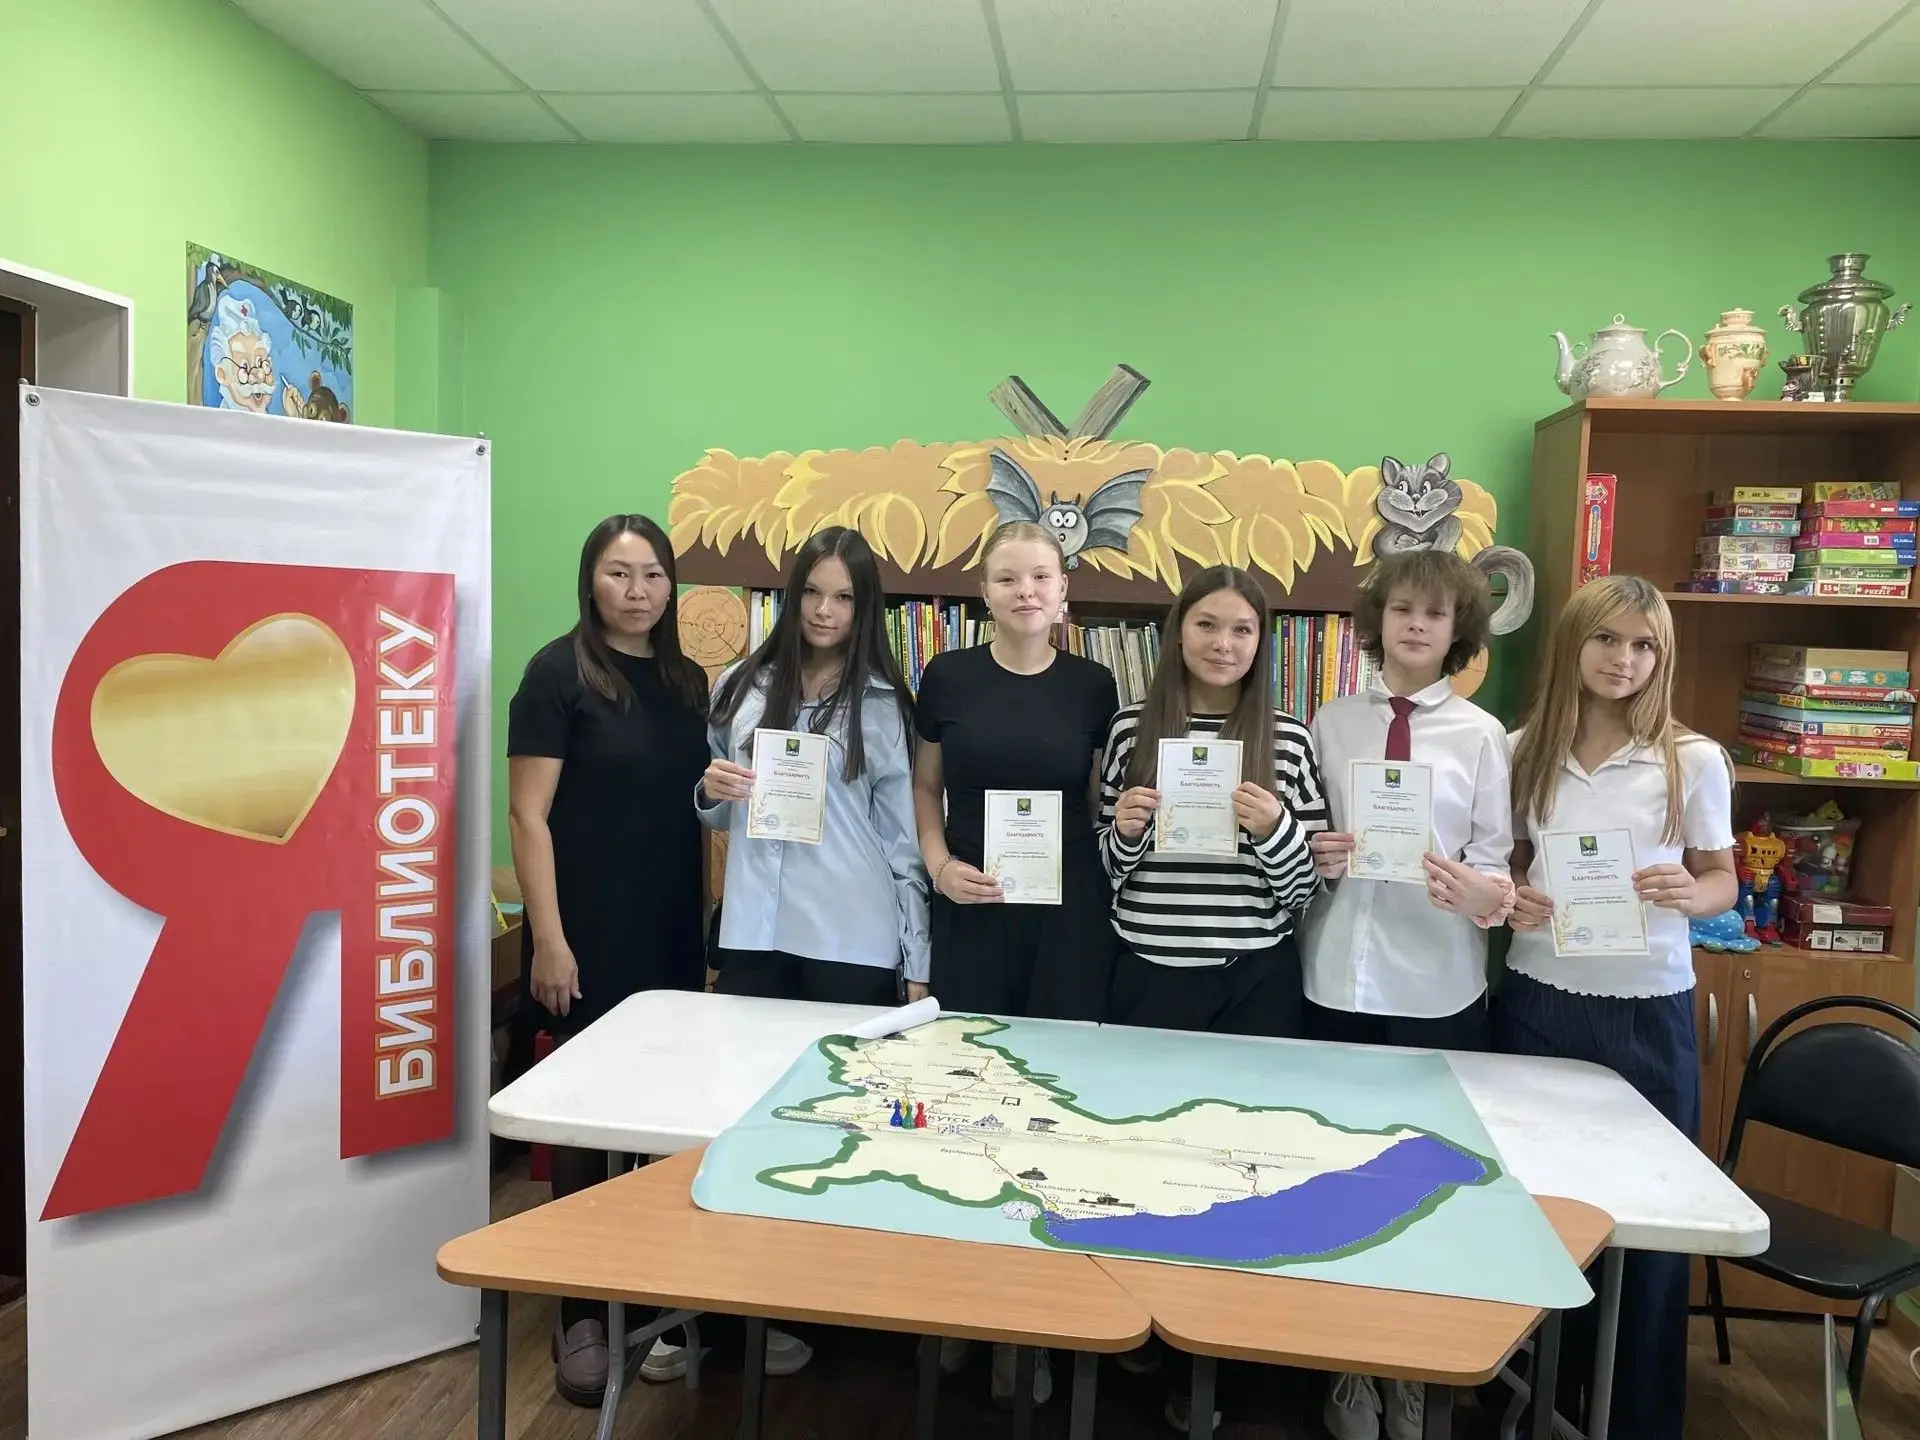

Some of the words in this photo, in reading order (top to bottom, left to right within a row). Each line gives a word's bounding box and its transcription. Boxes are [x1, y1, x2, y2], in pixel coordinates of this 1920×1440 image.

[39, 560, 455, 1221] Я
[374, 604, 439, 1100] БИБЛИОТЕКУ
[927, 1114, 970, 1124] КУТСК
